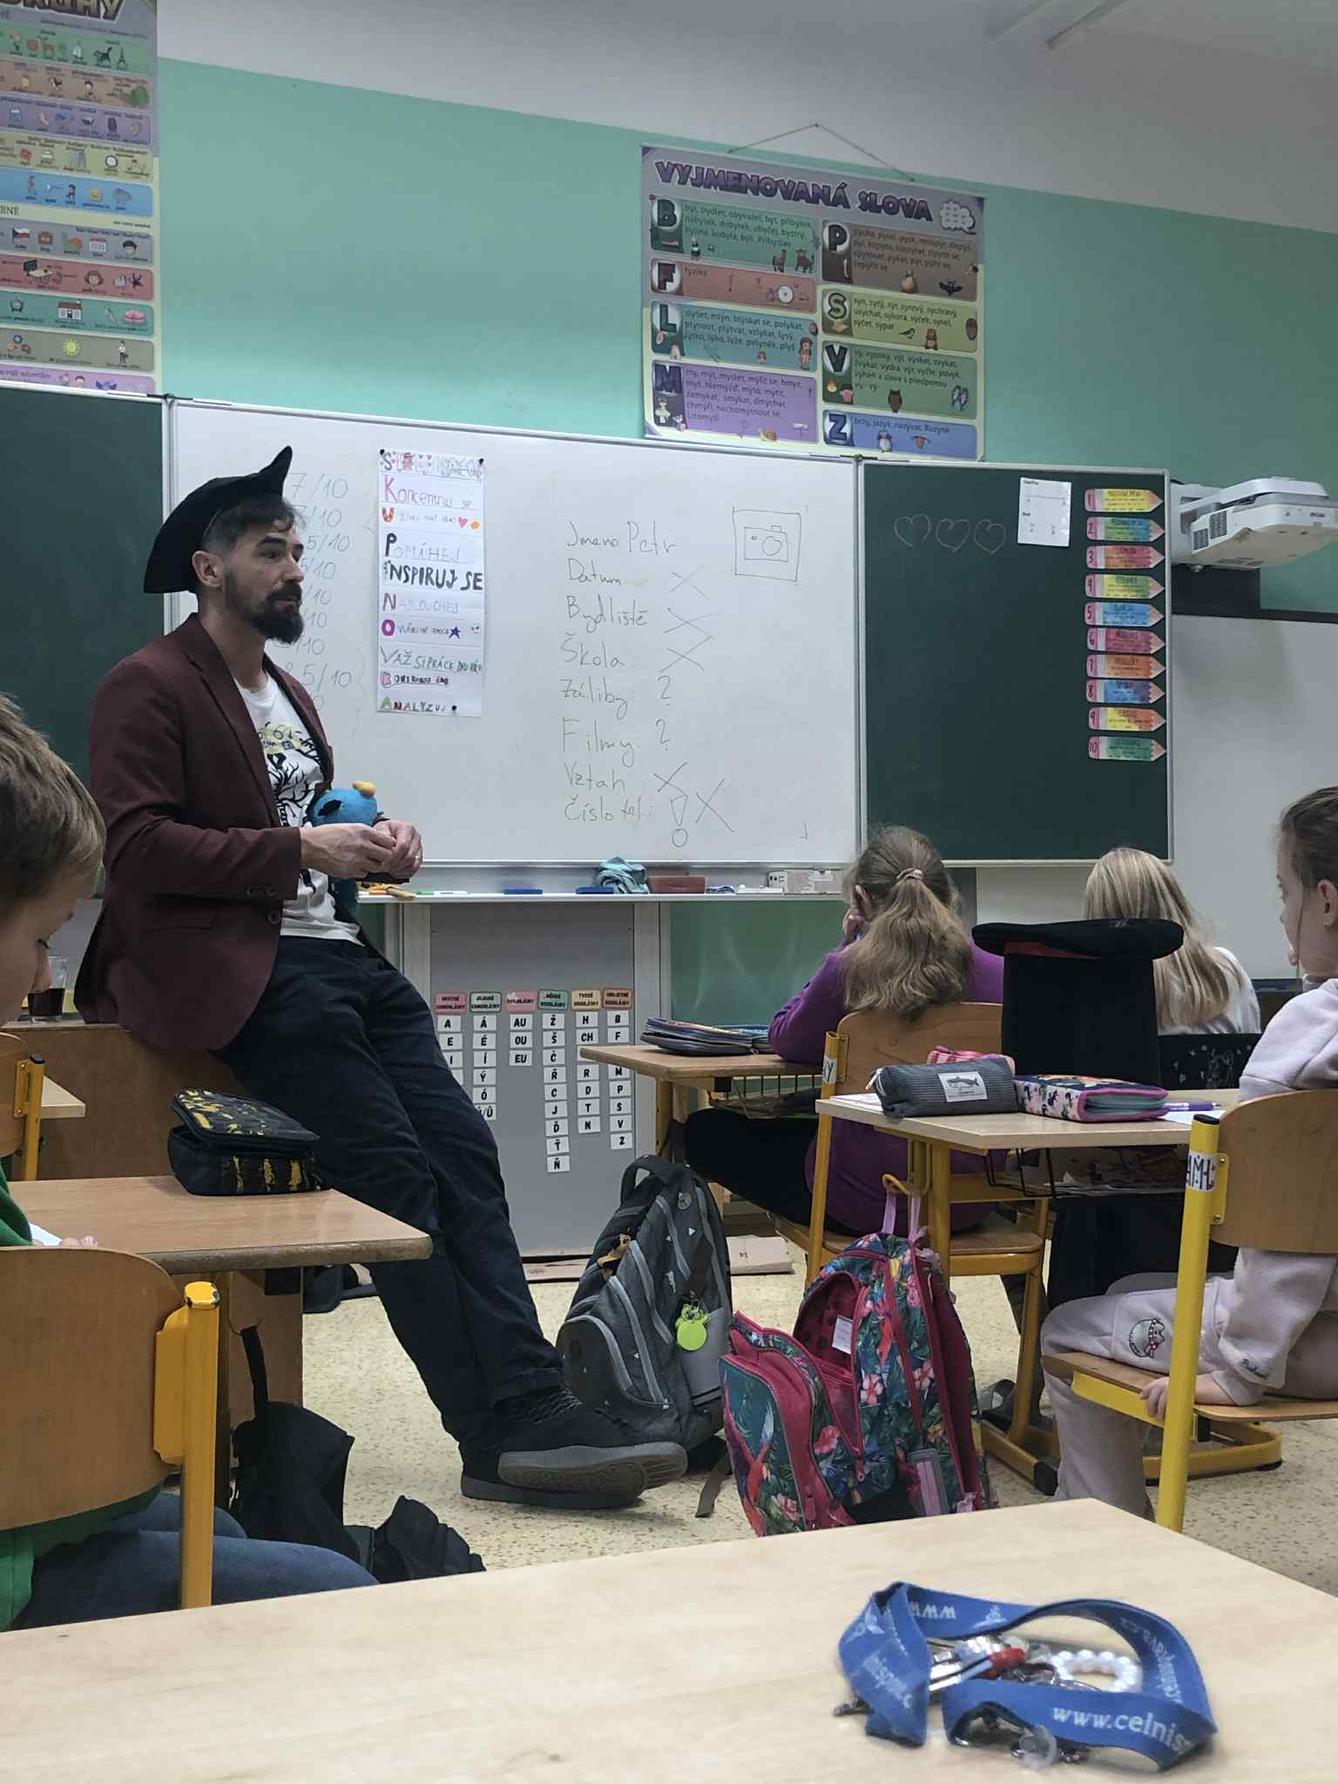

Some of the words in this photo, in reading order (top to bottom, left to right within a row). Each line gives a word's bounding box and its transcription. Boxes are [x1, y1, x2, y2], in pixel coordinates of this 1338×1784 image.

[655, 161, 850, 209] VYJMENOVANÁ
[858, 190, 933, 222] SLOVA
[657, 199, 677, 227] B
[828, 224, 848, 251] P
[658, 263, 676, 291] F
[828, 292, 847, 320] S
[659, 304, 677, 333] L
[825, 344, 848, 372] V
[655, 364, 682, 394] M
[828, 413, 848, 441] Z
[290, 472, 350, 501] 7/10
[1088, 550, 1094, 564] 3
[383, 560, 458, 590] INSPIRUJ
[460, 571, 484, 591] SE
[567, 557, 622, 586] Datum
[1089, 632, 1095, 645] 6
[564, 762, 626, 791] Vztah
[564, 794, 614, 823] Číslo
[444, 1019, 451, 1029] A
[480, 1016, 487, 1028] Á
[514, 1018, 527, 1027] AU
[583, 1016, 589, 1025] H
[615, 1015, 621, 1023] B
[447, 1037, 454, 1047] E
[481, 1034, 487, 1046] É
[515, 1036, 527, 1045] OU
[581, 1033, 593, 1042] CH
[615, 1032, 621, 1041] F
[515, 1054, 527, 1063] EU
[480, 1070, 486, 1082] Ý
[584, 1069, 590, 1078] R
[615, 1066, 622, 1076] M
[481, 1088, 487, 1100] Ó
[551, 1088, 557, 1097] C
[586, 1086, 591, 1095] D
[617, 1086, 623, 1094] P
[552, 1106, 557, 1115] J
[585, 1103, 591, 1112] T
[616, 1103, 622, 1112] S
[585, 1121, 591, 1130] N
[617, 1120, 623, 1128] V
[619, 1137, 625, 1145] Z
[1051, 1705, 1194, 1758] www.celnis
